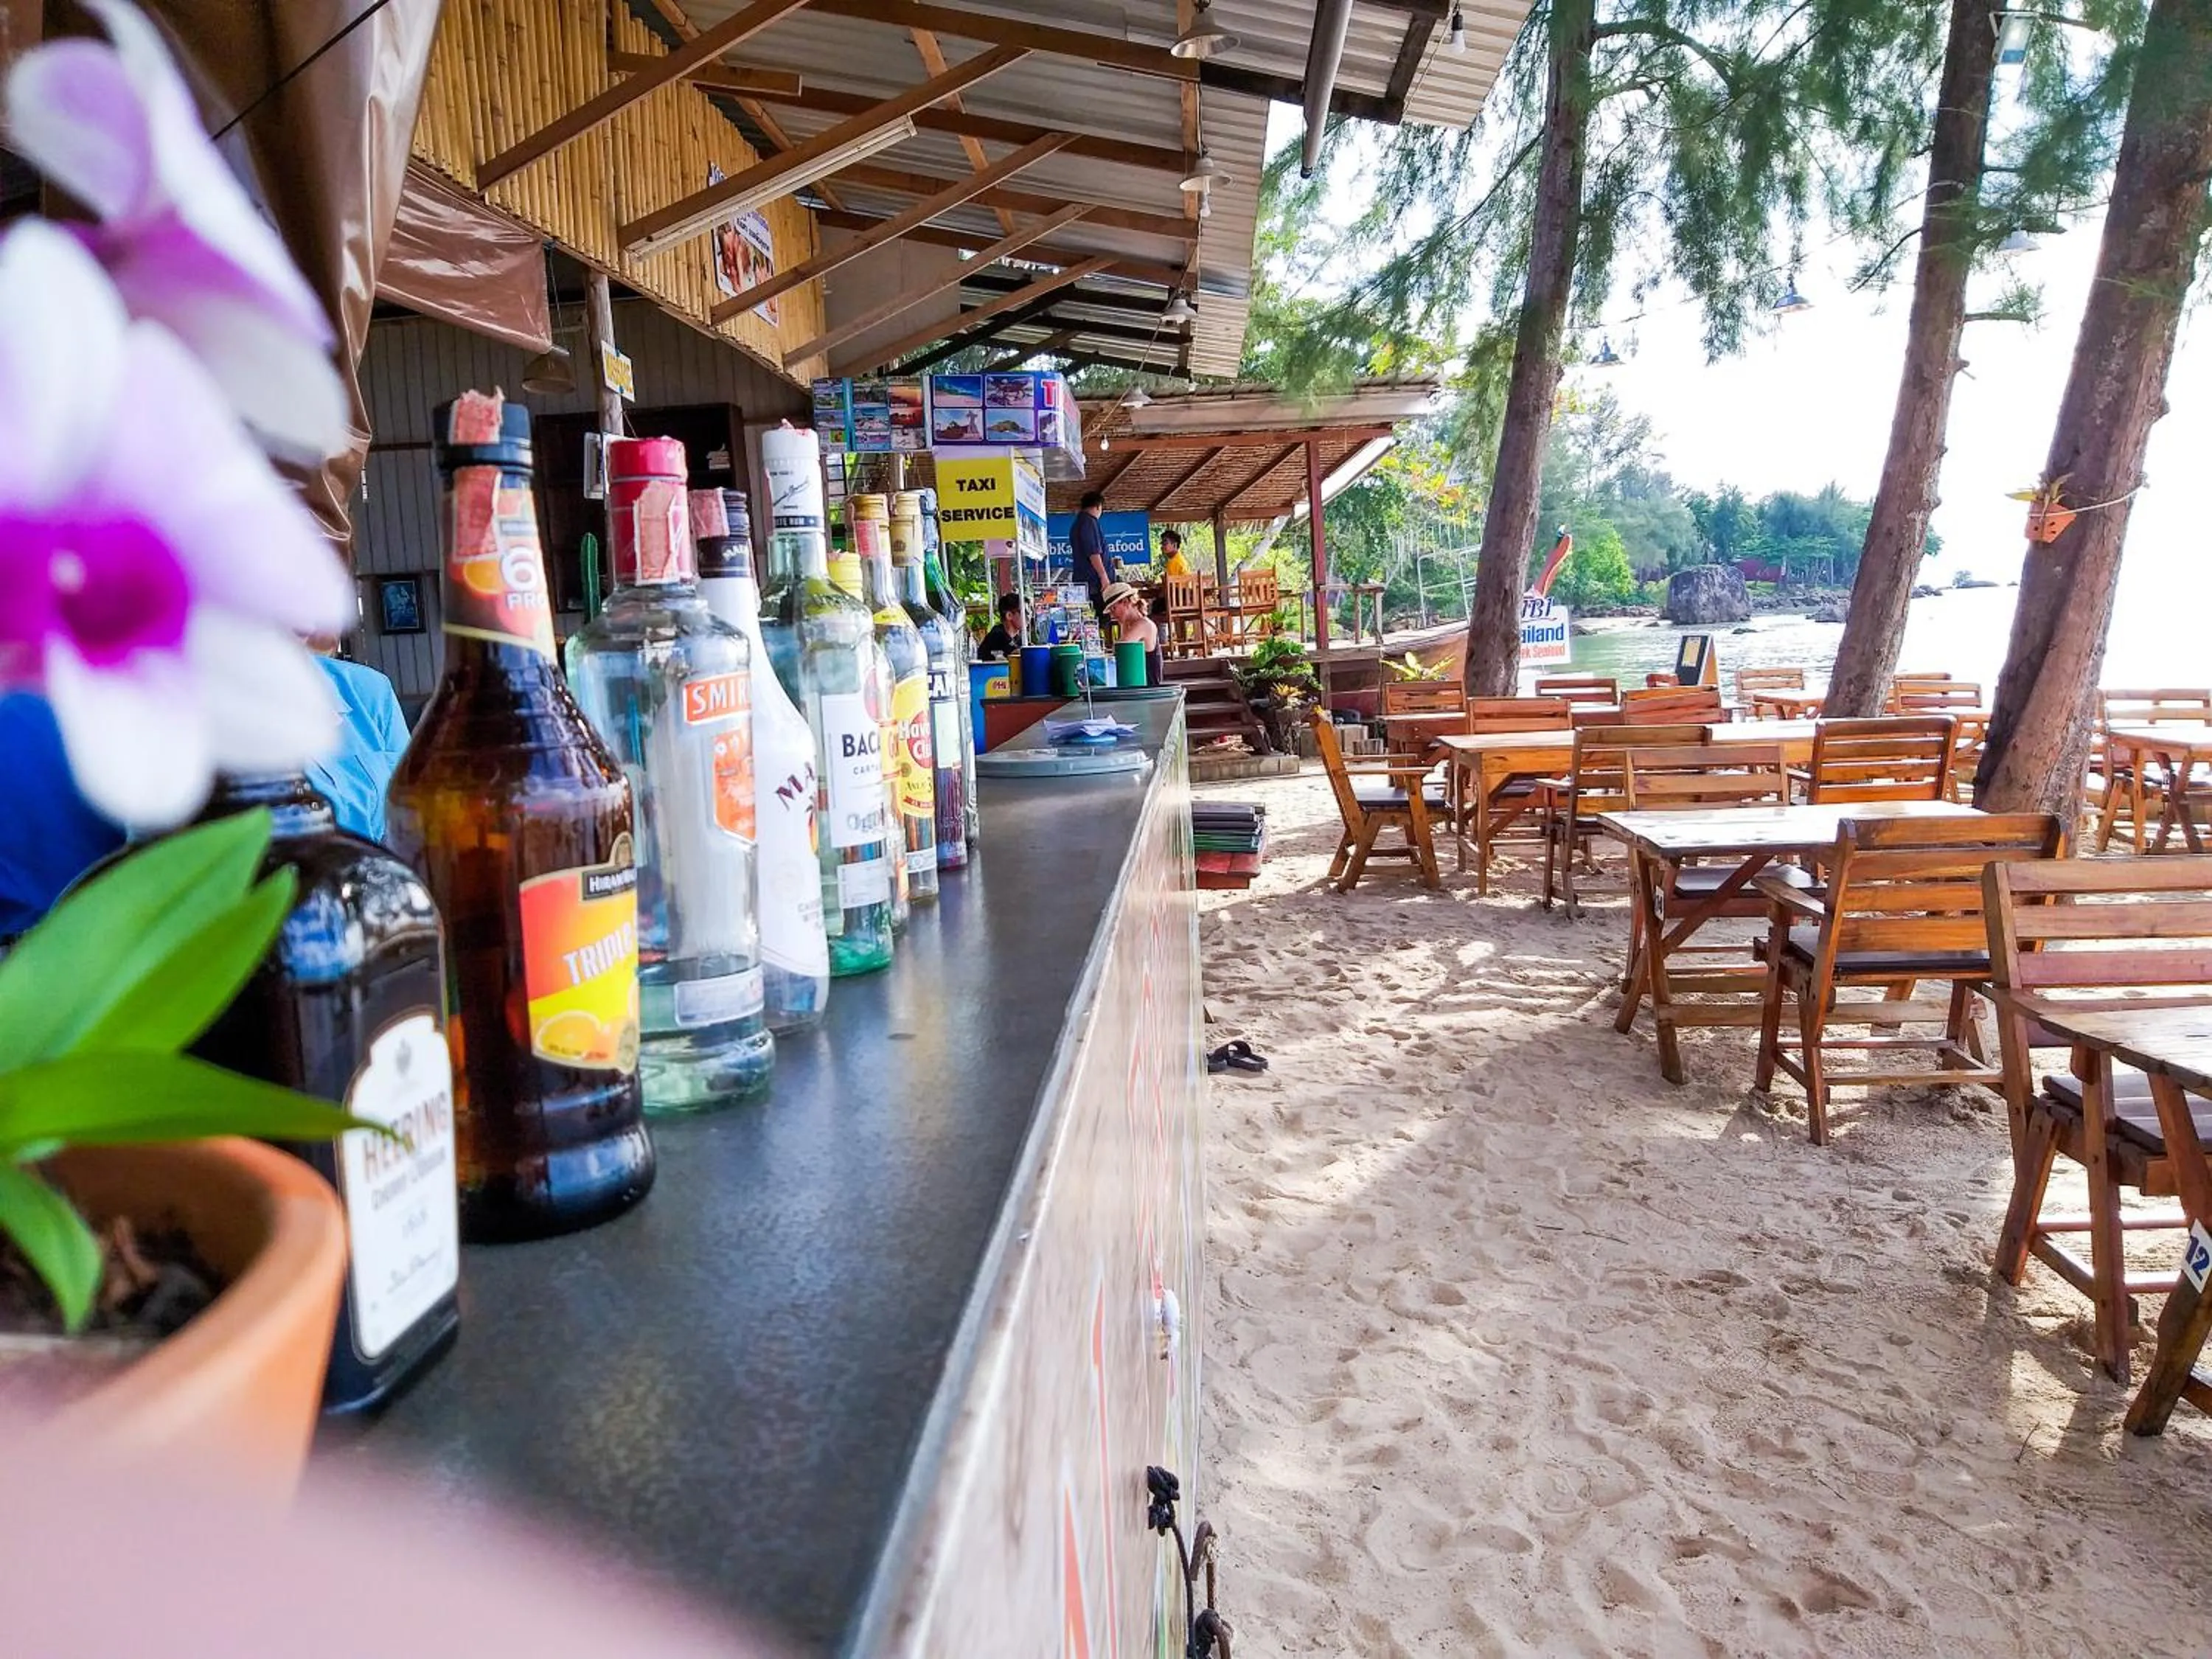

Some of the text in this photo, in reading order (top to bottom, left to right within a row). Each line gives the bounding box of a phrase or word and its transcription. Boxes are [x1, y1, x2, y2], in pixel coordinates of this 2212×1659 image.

[956, 478, 996, 493] TAXI
[941, 506, 1015, 523] SERVICE
[841, 731, 880, 757] BAC
[2185, 1234, 2210, 1282] 12
